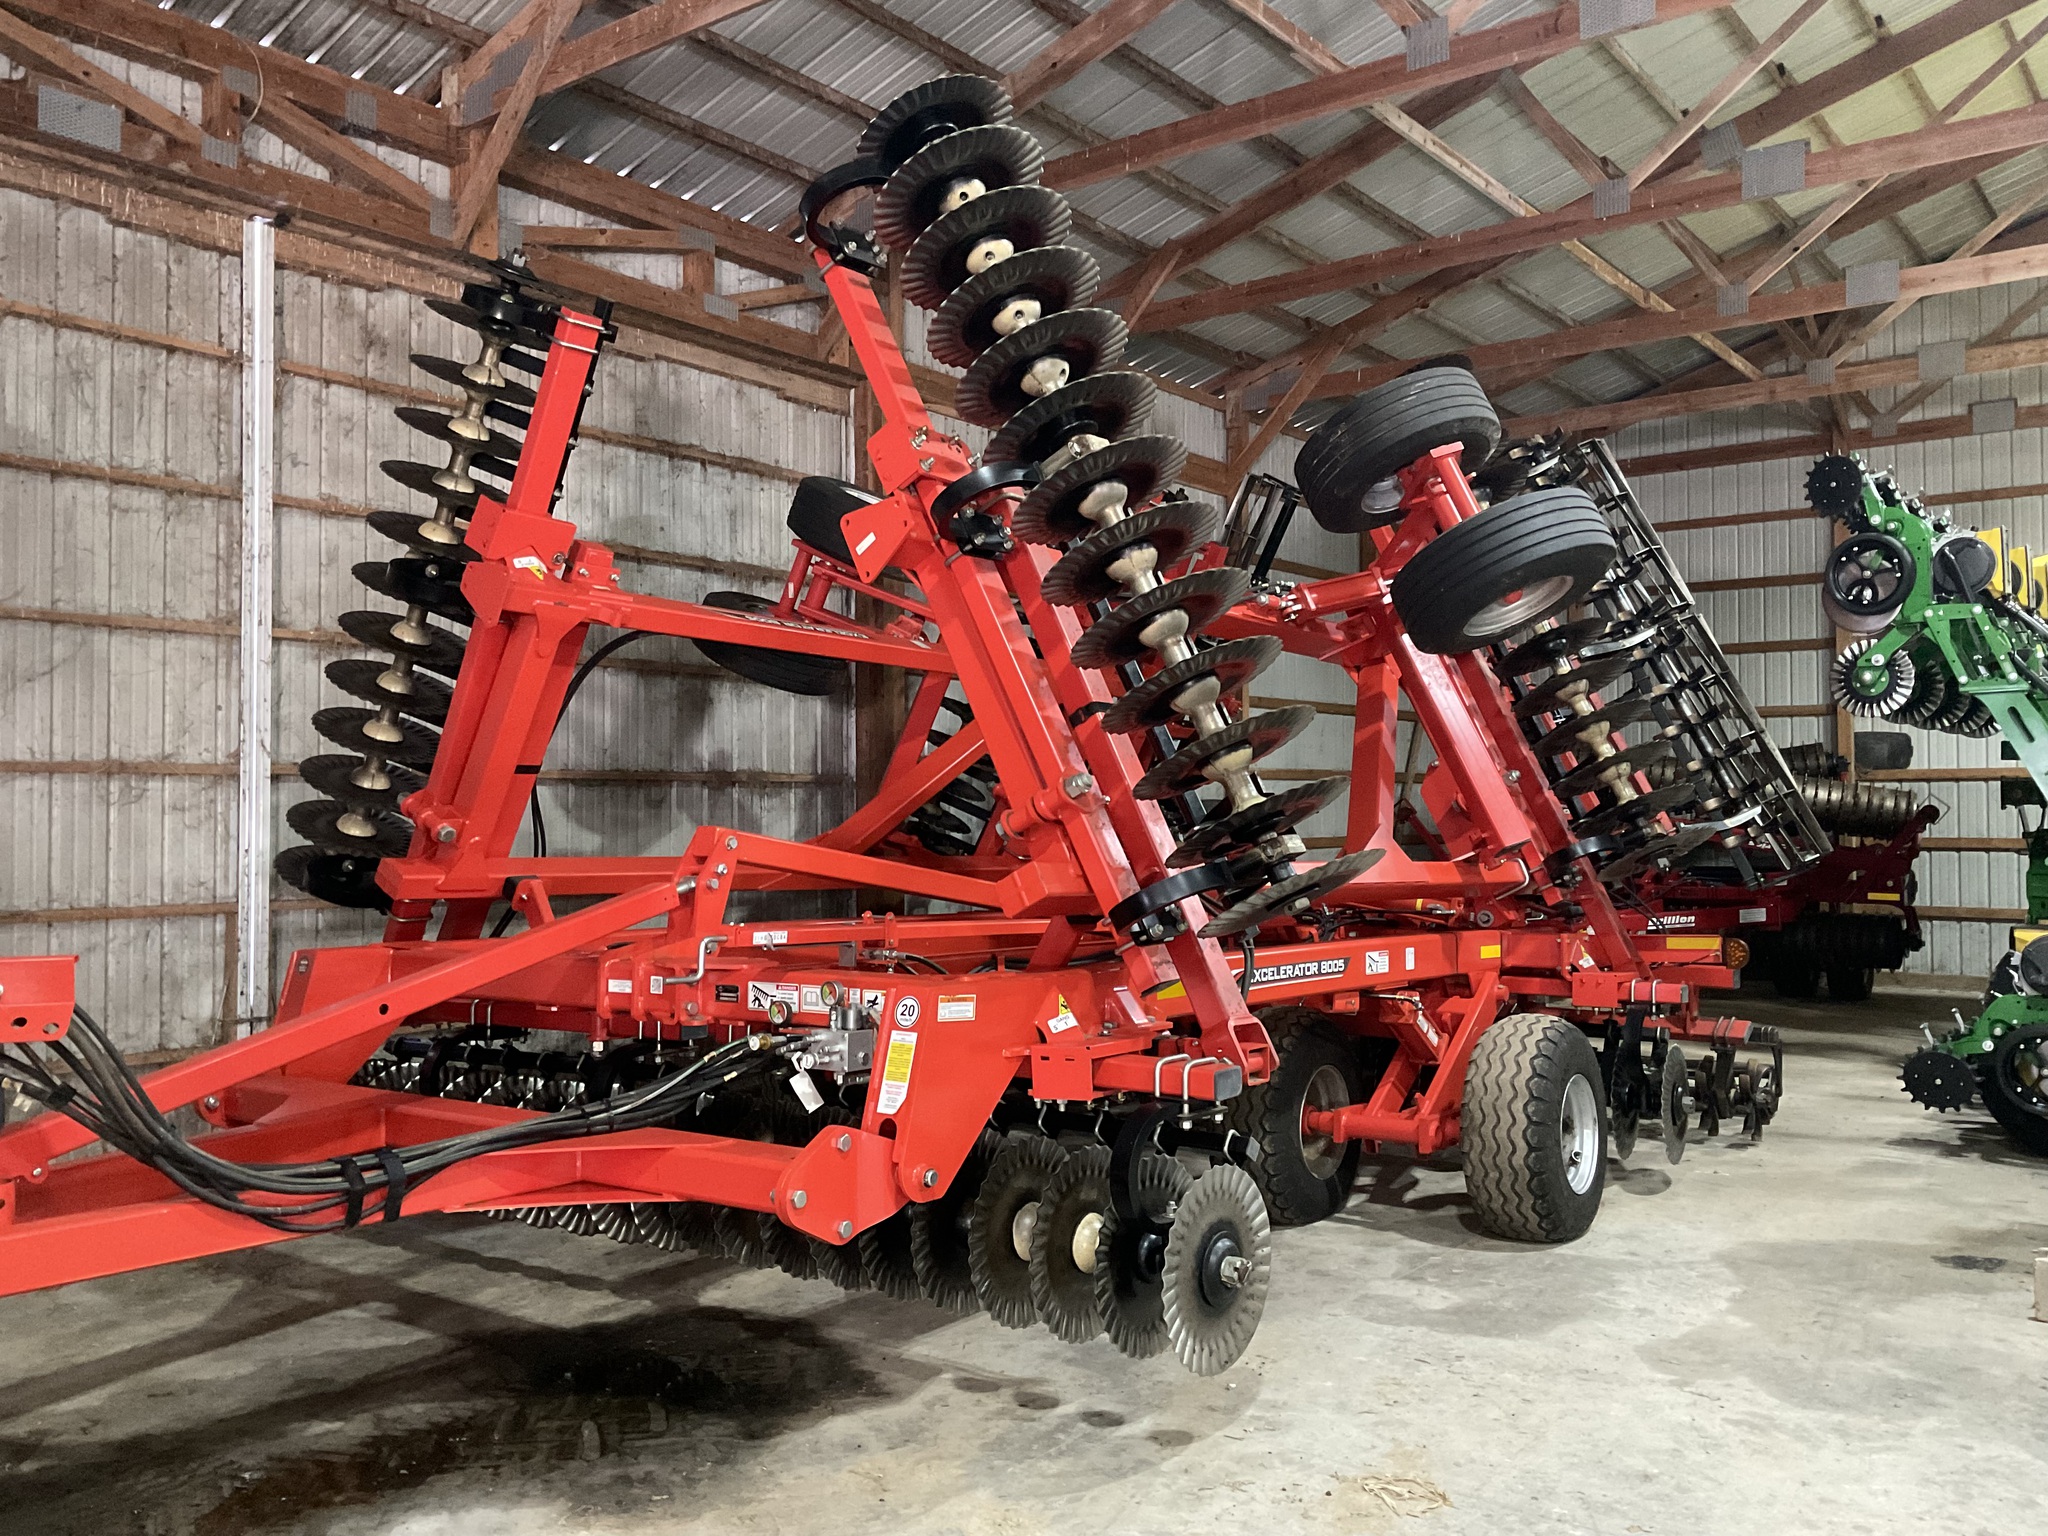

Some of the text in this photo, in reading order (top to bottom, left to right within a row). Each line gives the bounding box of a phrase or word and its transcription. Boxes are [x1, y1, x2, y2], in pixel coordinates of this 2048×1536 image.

[1251, 959, 1345, 983] XCELERATOR 8005
[899, 1003, 915, 1017] 20
